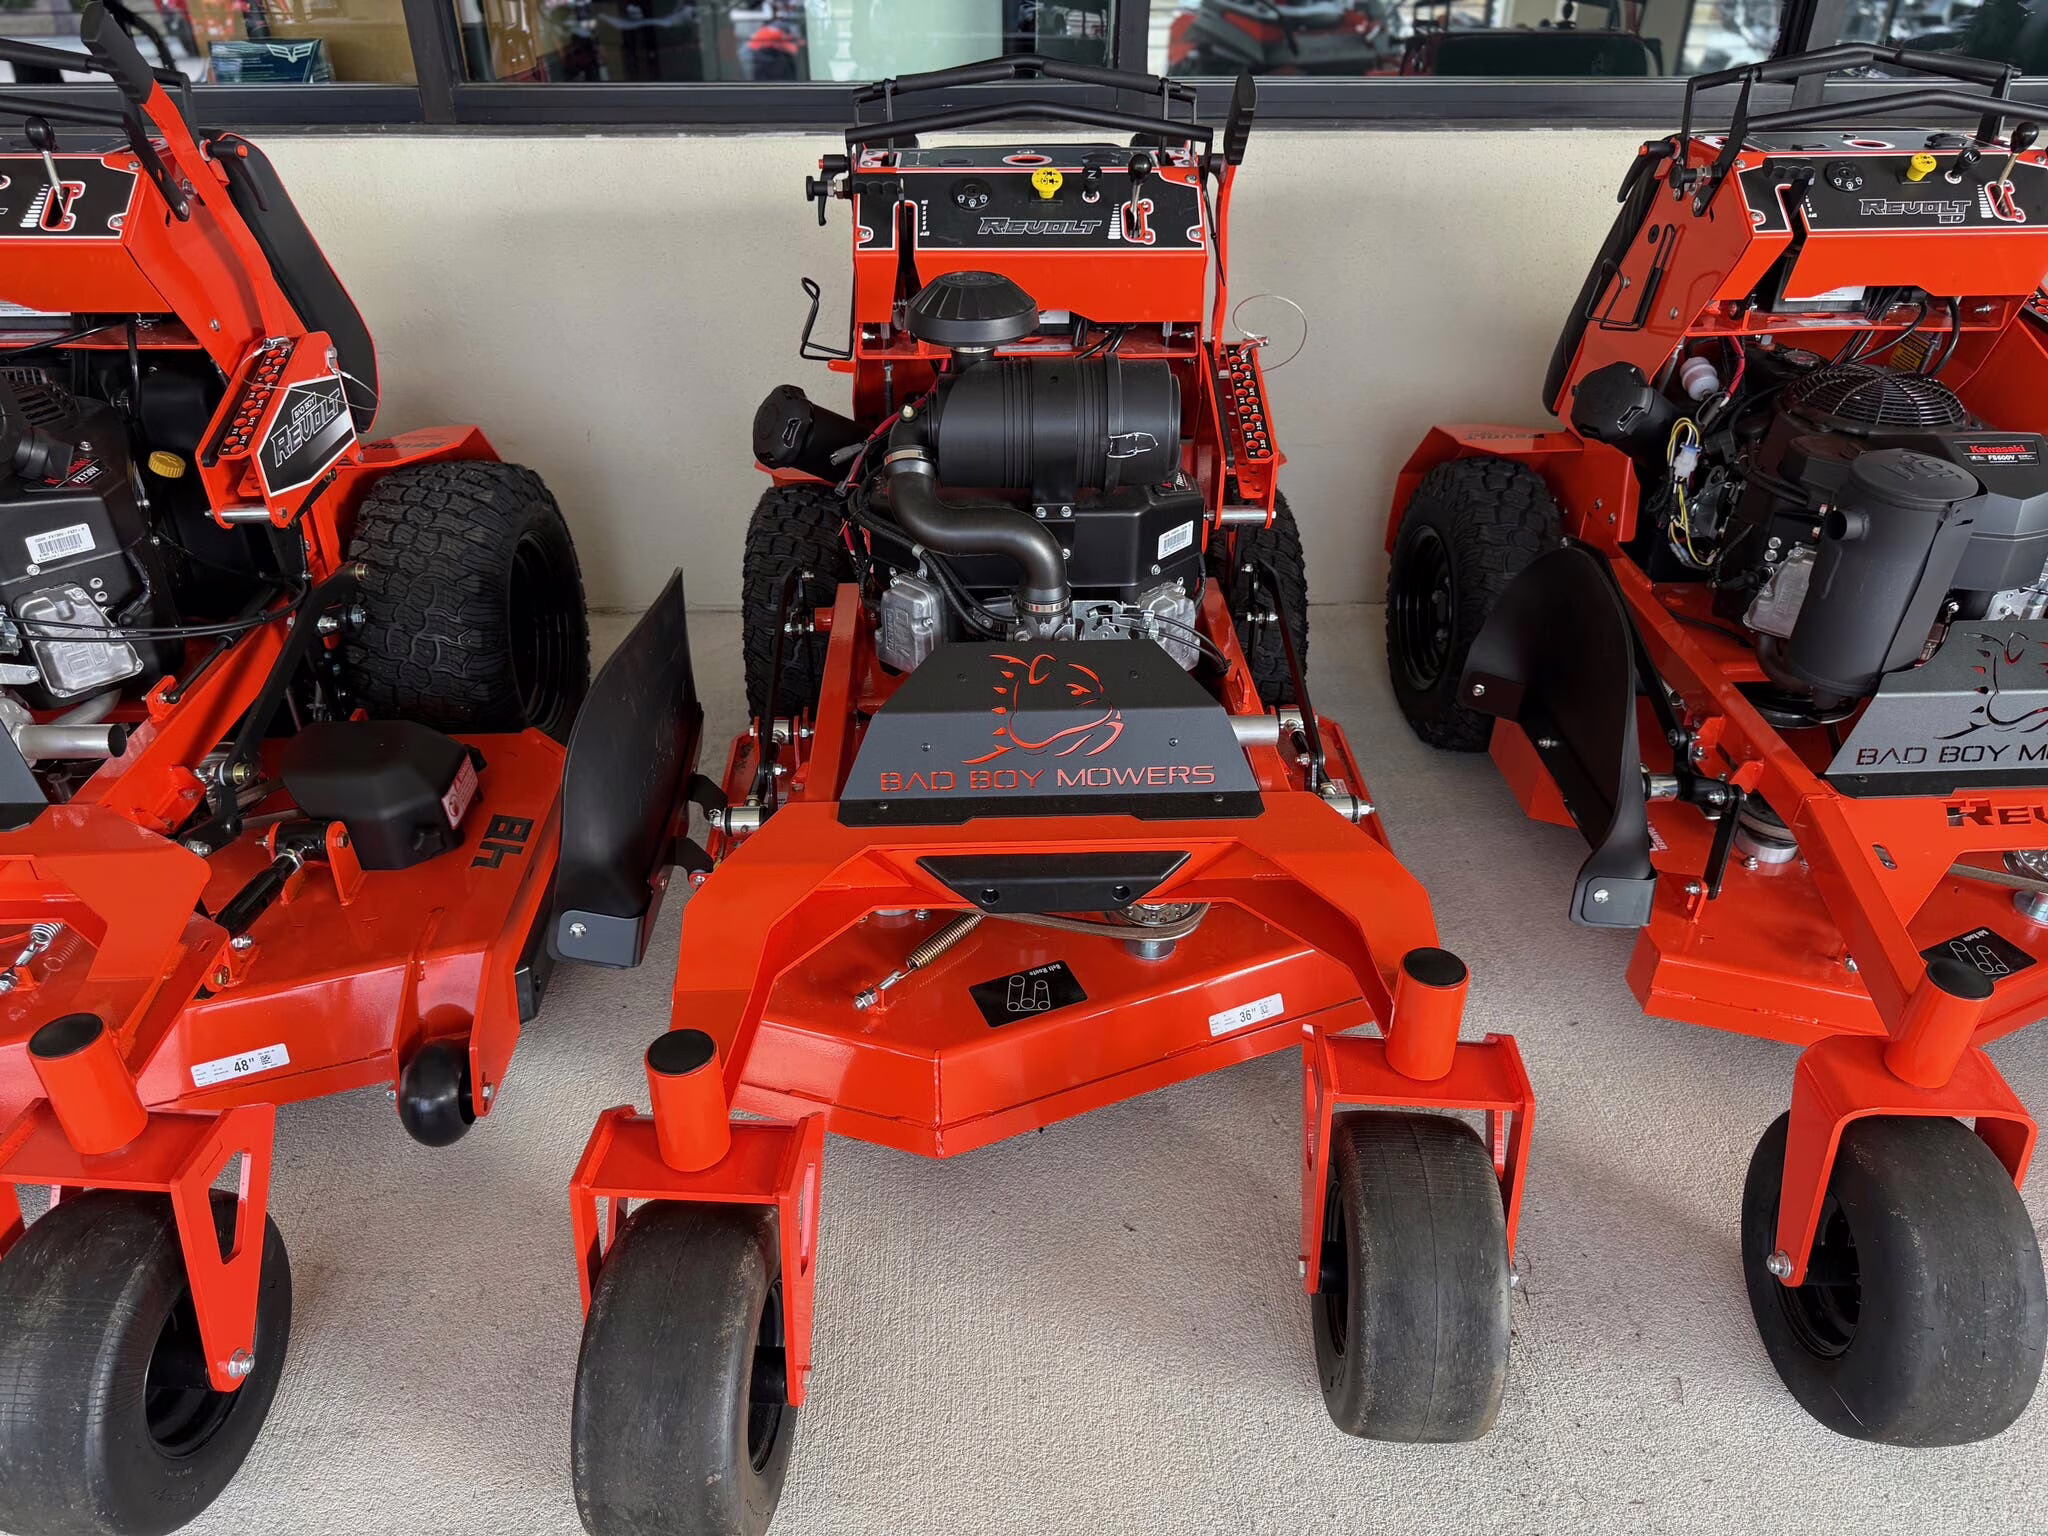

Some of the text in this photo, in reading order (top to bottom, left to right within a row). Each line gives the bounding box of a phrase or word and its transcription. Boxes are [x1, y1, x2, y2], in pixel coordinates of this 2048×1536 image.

[1858, 198, 1972, 215] REVOLT
[977, 217, 1102, 235] REVOLT
[271, 387, 341, 468] REVOLT
[1969, 444, 2026, 453] Kawasaki
[1856, 747, 1928, 766] BAD
[1938, 745, 2011, 763] BOY
[880, 764, 1216, 792] BAD BOY MOWERS
[470, 814, 535, 869] 48
[1239, 1008, 1257, 1023] 36"
[234, 1057, 255, 1072] 48"
